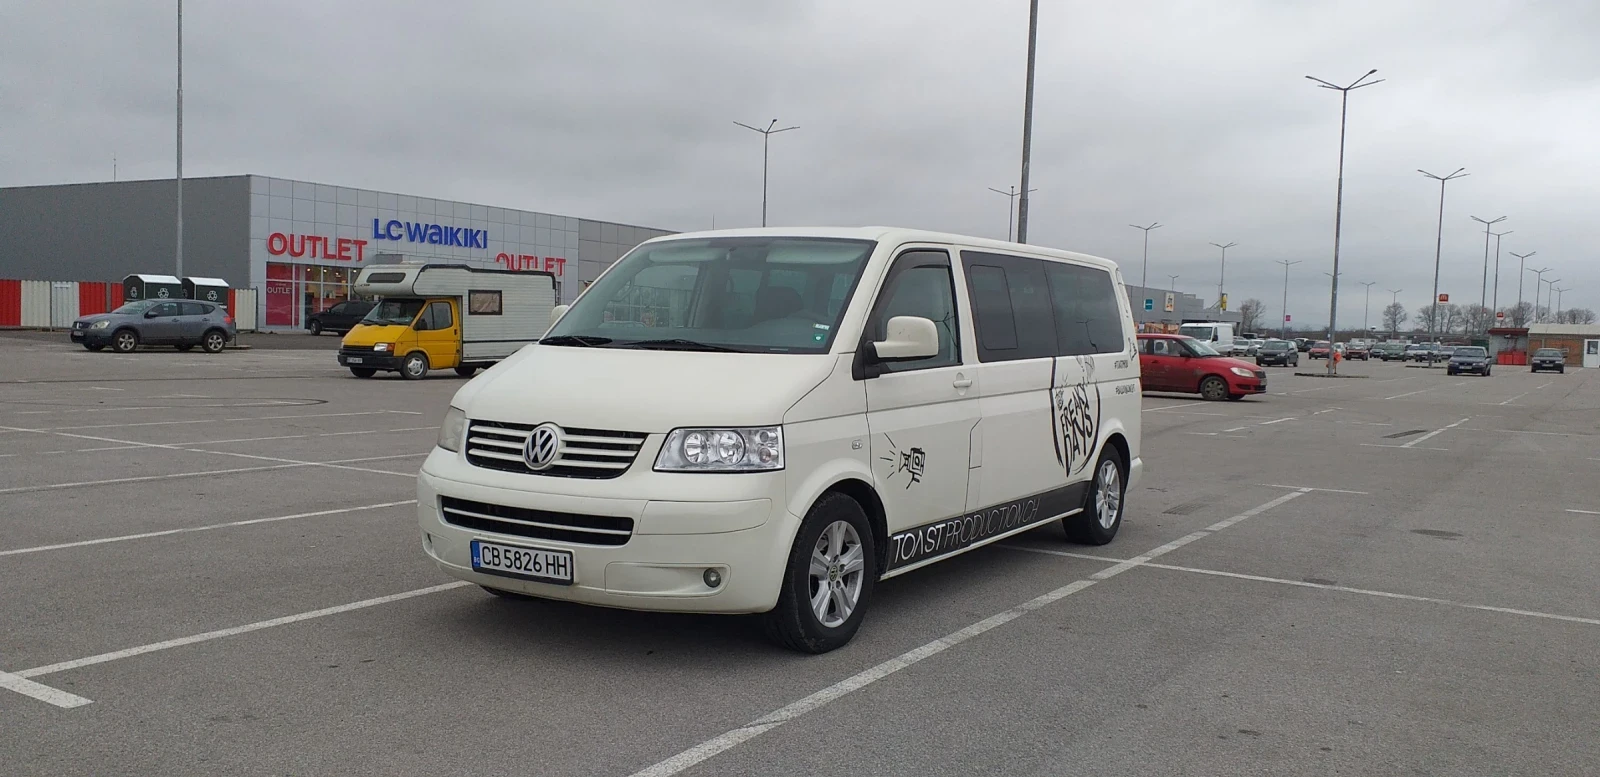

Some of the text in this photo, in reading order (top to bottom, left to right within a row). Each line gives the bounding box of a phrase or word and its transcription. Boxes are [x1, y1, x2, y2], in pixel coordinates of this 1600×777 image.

[373, 218, 403, 241] LC
[267, 232, 368, 262] OUTLET
[1060, 382, 1090, 432] FREAKY
[1064, 406, 1093, 478] DAYS
[482, 546, 568, 577] CB 5826 HH
